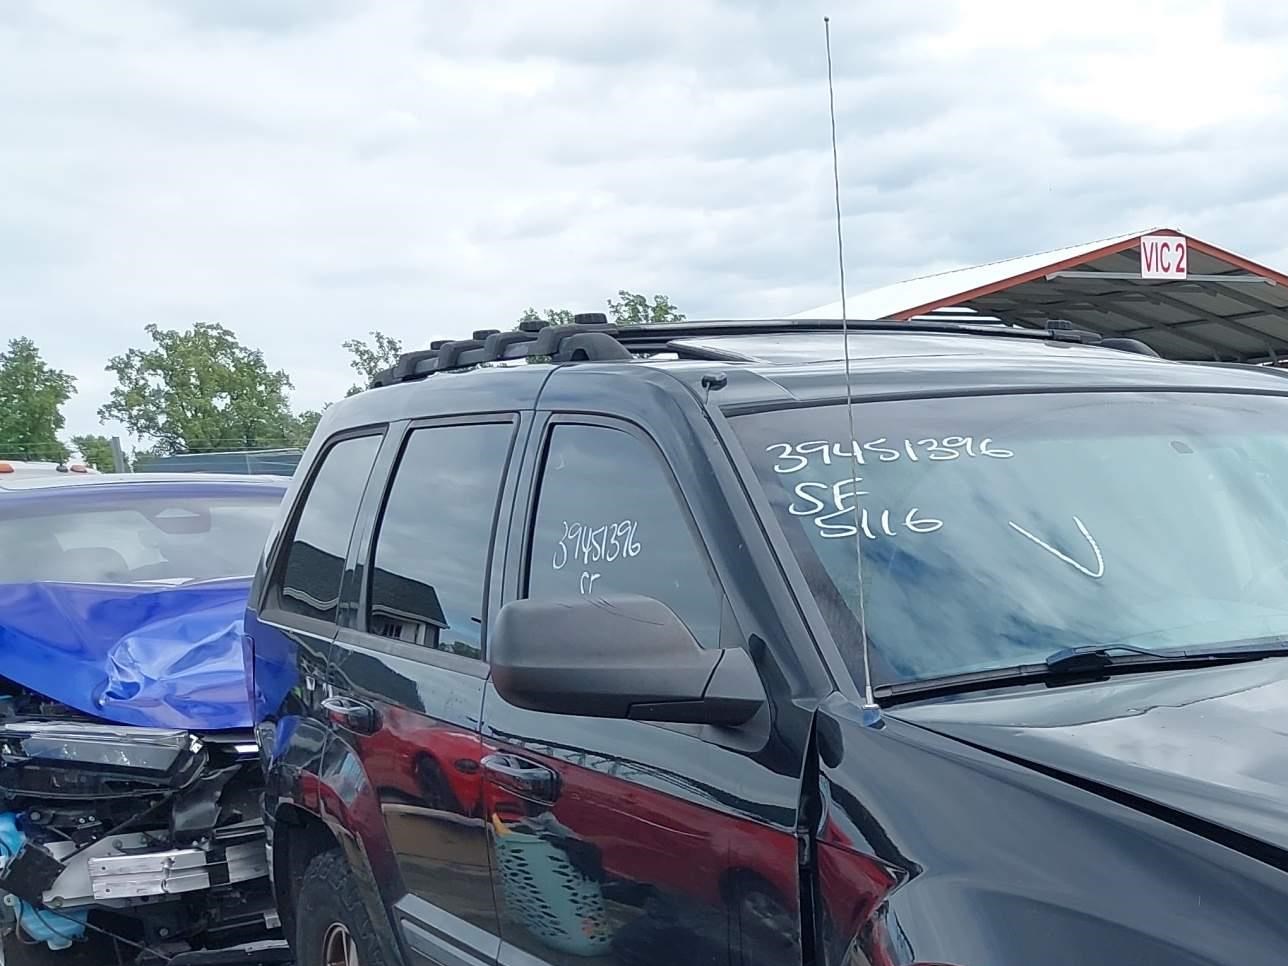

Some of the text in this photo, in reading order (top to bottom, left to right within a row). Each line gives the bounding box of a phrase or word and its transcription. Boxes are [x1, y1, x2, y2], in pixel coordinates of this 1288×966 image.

[1142, 241, 1185, 273] VIC 2
[765, 436, 1014, 473] 39451396
[788, 477, 870, 515] SF
[552, 520, 641, 570] 39451396
